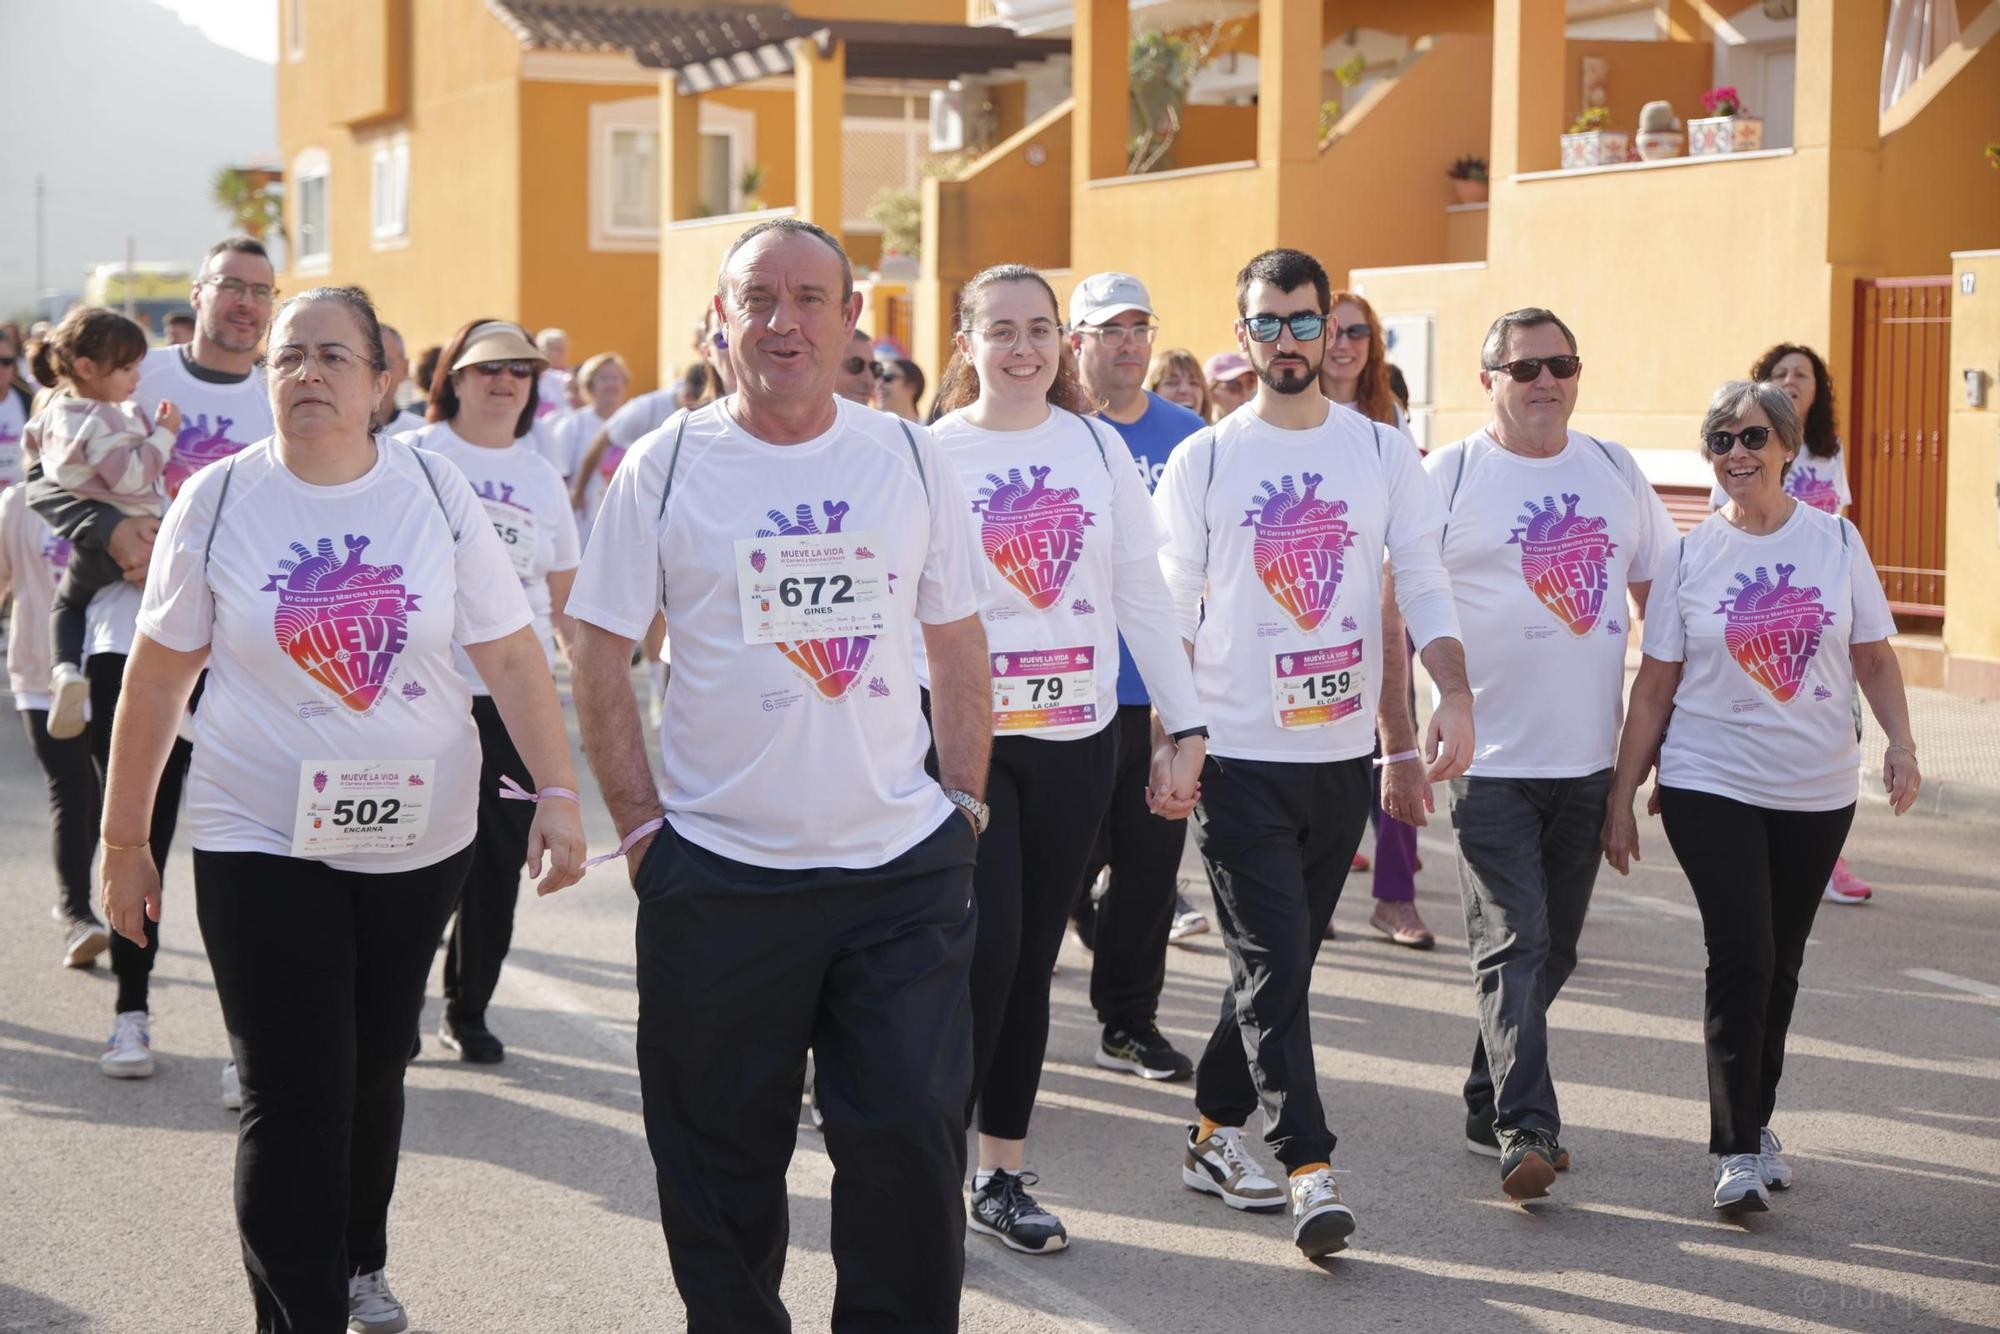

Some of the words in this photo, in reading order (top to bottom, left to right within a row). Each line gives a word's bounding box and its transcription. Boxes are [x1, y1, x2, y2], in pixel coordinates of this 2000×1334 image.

[1028, 509, 1053, 518] Marcha
[1296, 525, 1319, 534] Marcha
[781, 549, 809, 558] MUEVE
[811, 549, 822, 557] LA
[823, 547, 845, 556] VIDA
[993, 530, 1084, 577] MUEVE
[1562, 540, 1583, 549] Marcha
[1007, 560, 1072, 599] VIDA
[1263, 550, 1344, 595] MUEVE
[1534, 562, 1608, 605] MUEVE
[284, 594, 294, 602] VI
[294, 595, 329, 603] Carrera
[336, 590, 368, 600] Marcha
[369, 588, 401, 596] Urbana
[779, 575, 855, 607] 672
[1272, 580, 1337, 618] VIDA
[804, 606, 833, 616] GINES
[1546, 589, 1603, 625] VIDA
[1770, 609, 1794, 618] Marcha
[289, 616, 408, 671] MUEVE
[1737, 629, 1820, 673] MUEVE
[1020, 656, 1044, 664] MUEVE
[1054, 653, 1069, 661] VIDA
[308, 652, 394, 698] VIDA
[1302, 671, 1350, 699] 159
[1748, 655, 1809, 692] VIDA
[1027, 676, 1063, 702] 79
[341, 773, 369, 781] MUEVE
[332, 799, 401, 826] 502
[343, 826, 383, 834] ENCARNA
